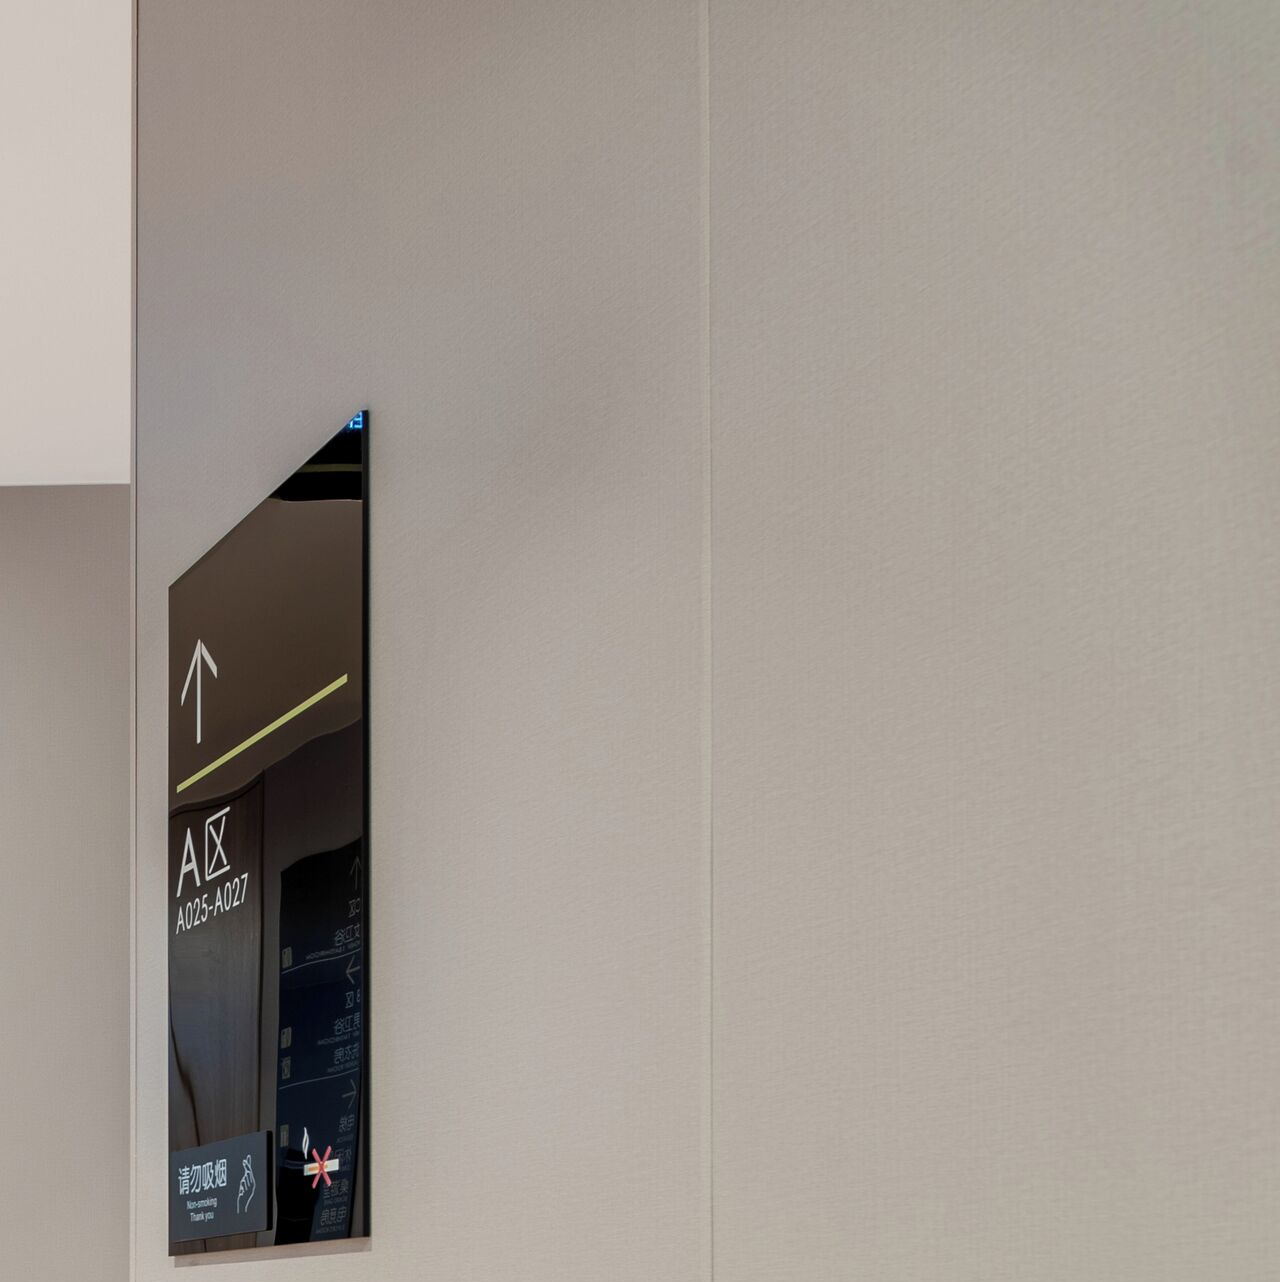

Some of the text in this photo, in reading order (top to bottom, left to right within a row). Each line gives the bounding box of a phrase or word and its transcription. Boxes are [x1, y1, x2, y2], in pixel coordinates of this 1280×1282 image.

[176, 806, 231, 898] A区
[175, 872, 249, 935] A025-A027
[178, 1158, 227, 1195] 请勿吸烟
[187, 1197, 218, 1210] Non-smoking
[190, 1211, 215, 1222] Thank you
